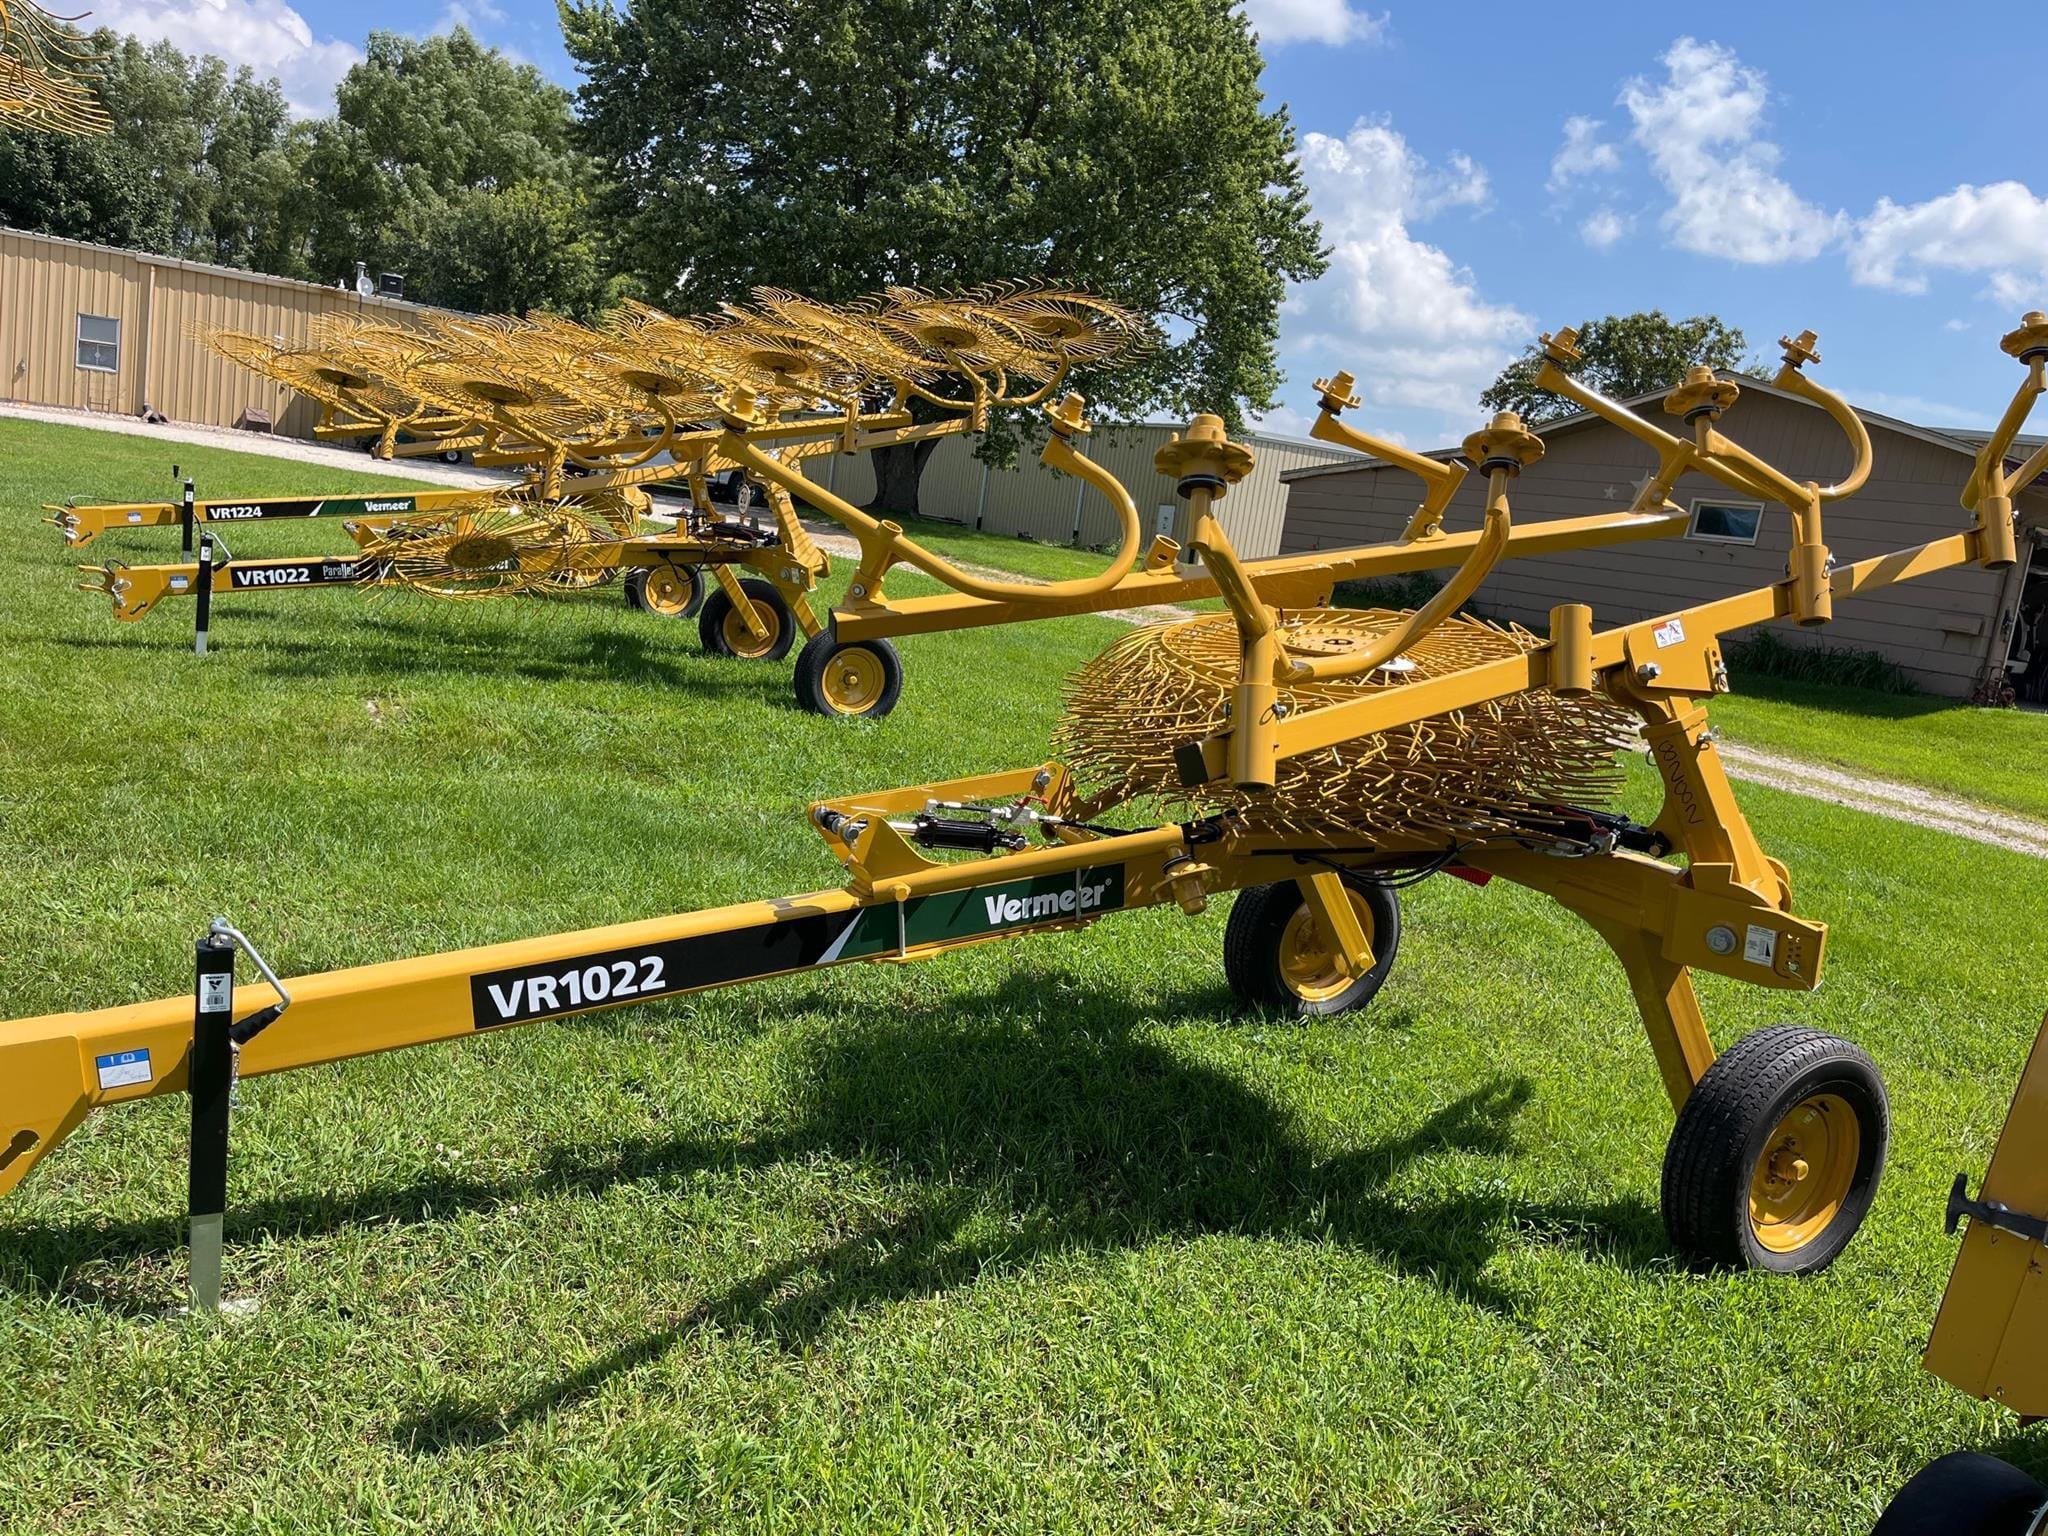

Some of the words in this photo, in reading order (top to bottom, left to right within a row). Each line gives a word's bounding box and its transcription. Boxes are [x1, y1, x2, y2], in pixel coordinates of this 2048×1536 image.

[210, 506, 263, 519] VR1224
[237, 567, 310, 586] VR1022
[487, 955, 666, 1018] VR1022
